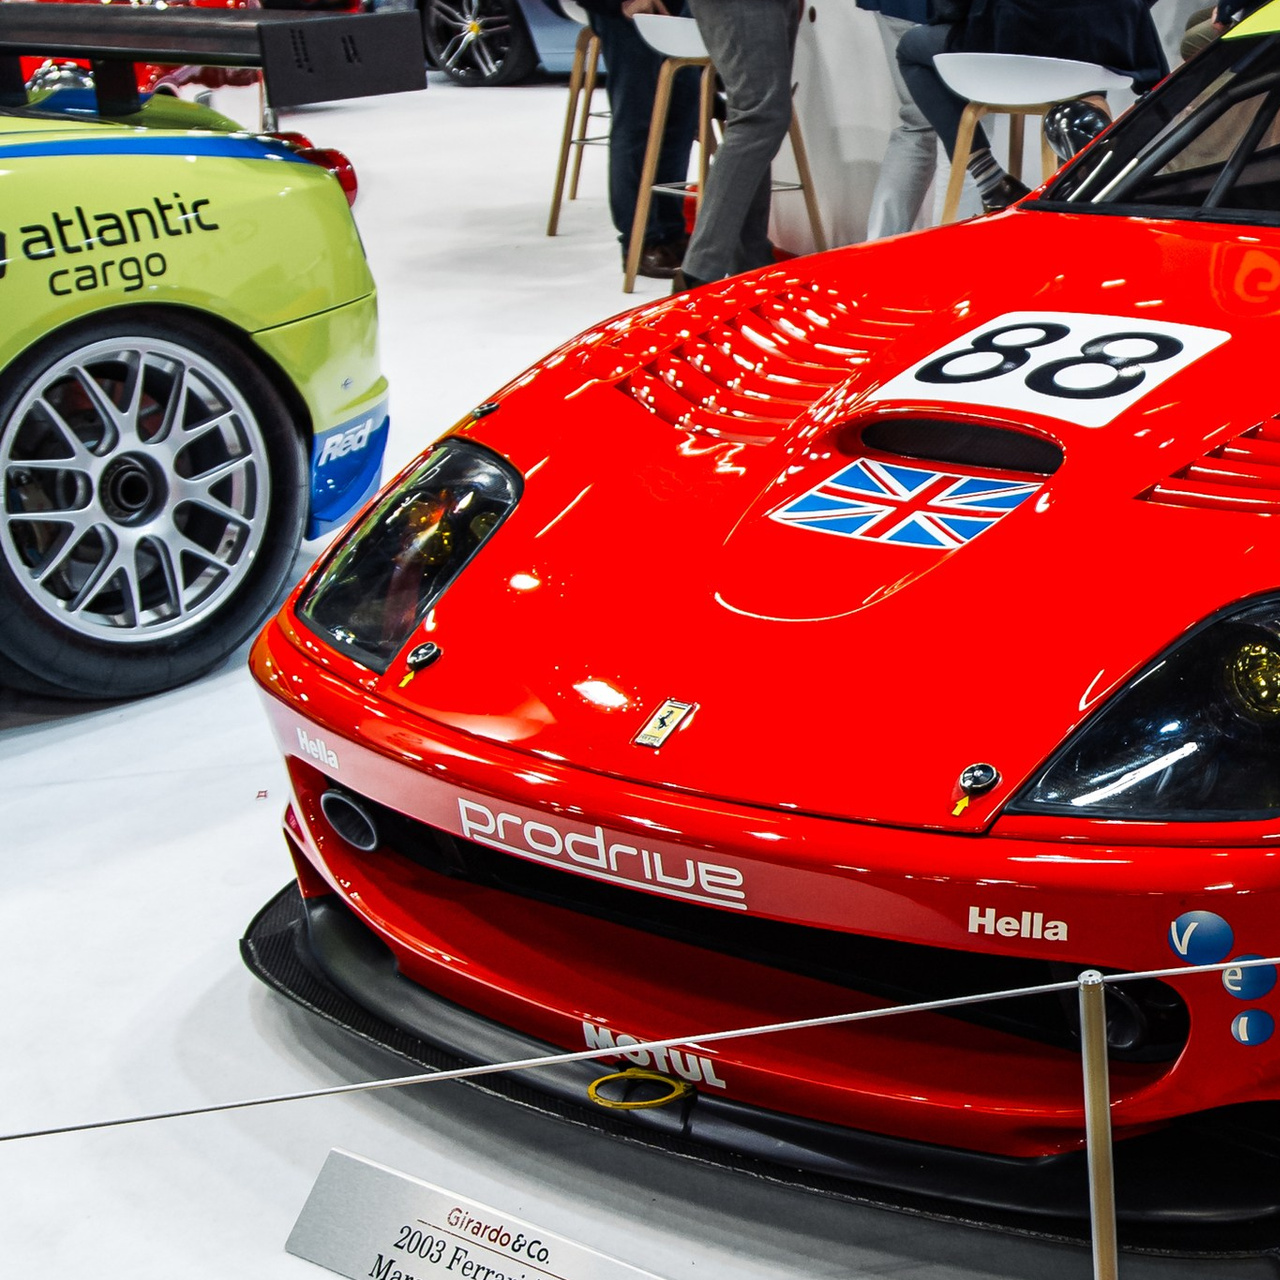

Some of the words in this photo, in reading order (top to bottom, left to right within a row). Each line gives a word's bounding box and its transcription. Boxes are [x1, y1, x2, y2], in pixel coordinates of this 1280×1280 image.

[20, 193, 219, 261] atlantic
[49, 252, 167, 297] cargo
[914, 322, 1185, 399] 88
[296, 727, 339, 770] Hella
[457, 797, 747, 900] prodrive
[968, 907, 1069, 942] Hella
[582, 1021, 727, 1089] MOTUL
[392, 1224, 447, 1264] 2003
[446, 1206, 550, 1265] Girardo&Co.
